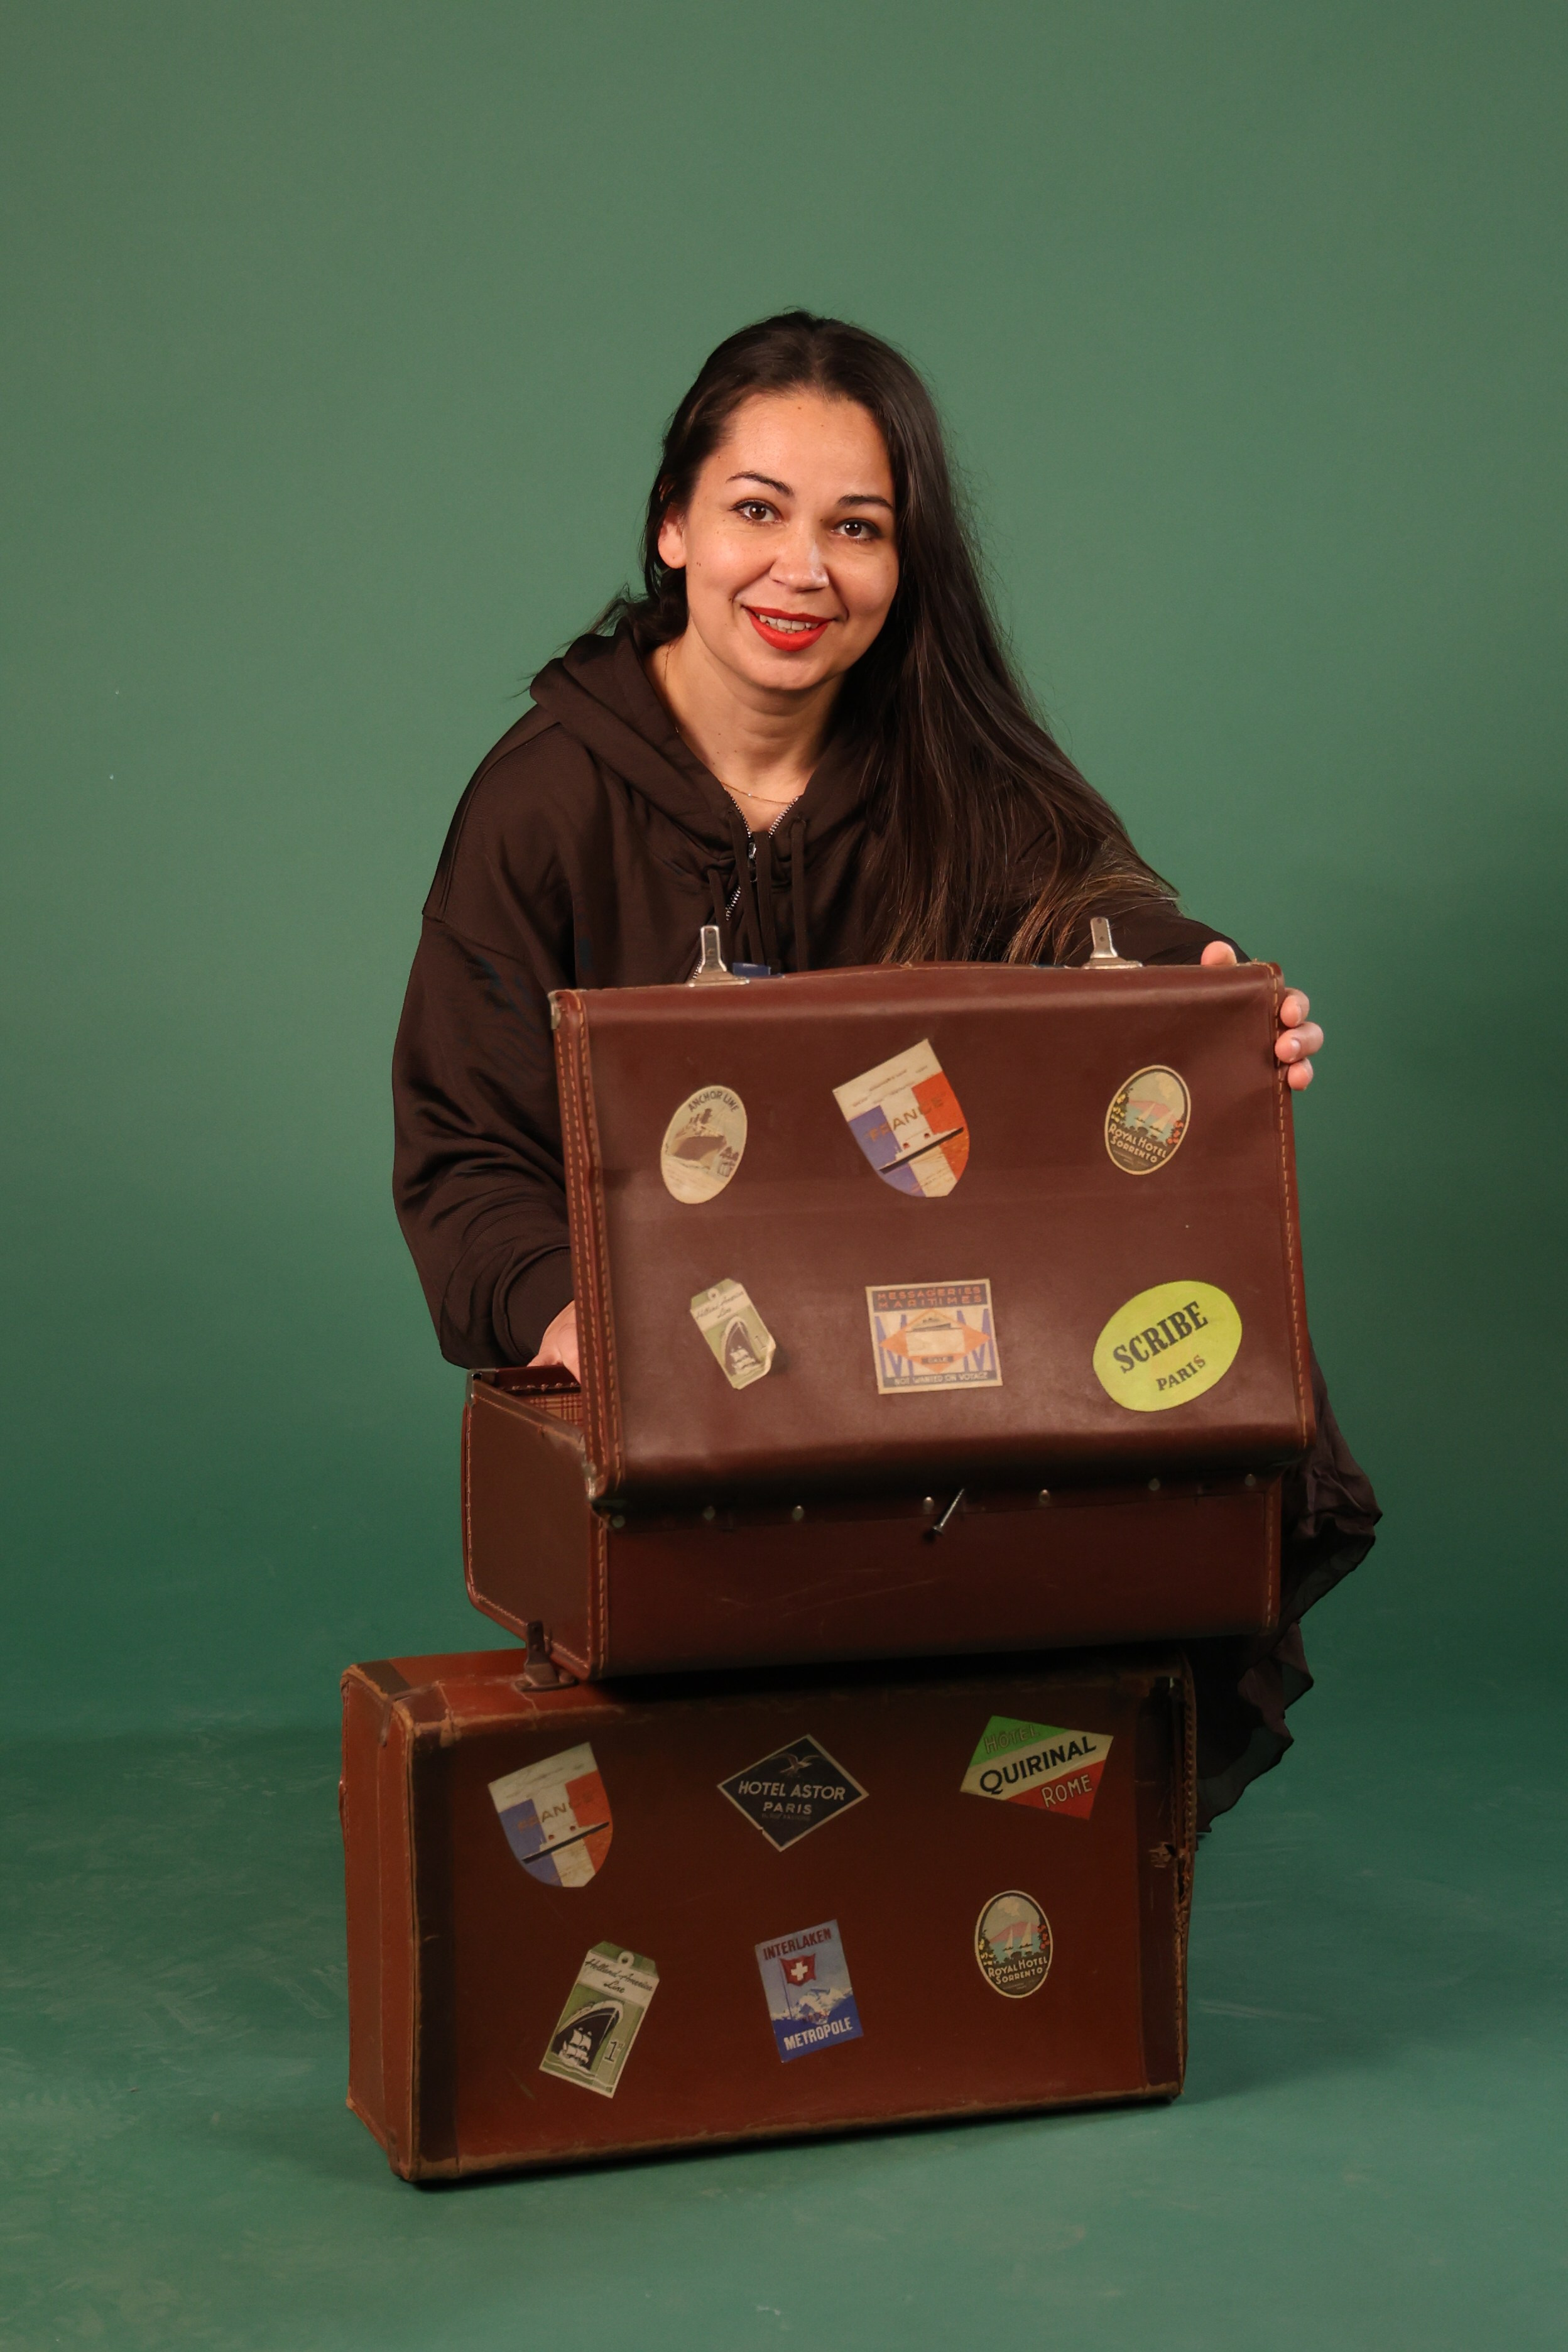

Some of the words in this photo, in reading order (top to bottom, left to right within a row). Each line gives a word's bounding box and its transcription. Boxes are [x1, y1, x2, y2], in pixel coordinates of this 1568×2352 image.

[687, 1091, 722, 1112] ANCHOR
[723, 1093, 739, 1112] LINE
[1108, 1123, 1136, 1145] ROYAL
[1138, 1136, 1167, 1158] HOTEL
[1110, 1135, 1158, 1163] SORRENTO
[878, 1287, 981, 1300] MESSAGERIES
[878, 1295, 983, 1309] MARITIMES
[1113, 1300, 1209, 1374] SCRIBE
[1156, 1354, 1206, 1391] PARIS
[979, 1736, 1097, 1795] QUIRINAL
[738, 1780, 786, 1797] HOTEL
[790, 1783, 846, 1801] ASTOR
[1040, 1774, 1092, 1809] ROME
[763, 1801, 812, 1814] PARIS
[763, 1927, 832, 1961] INTERLAKEN
[988, 1964, 1018, 1978] ROYAL
[1018, 1956, 1048, 1969] HOTEL
[996, 1967, 1043, 1985] SORRENTO
[603, 1980, 625, 1994] Line
[783, 2017, 853, 2051] METROPOLE
